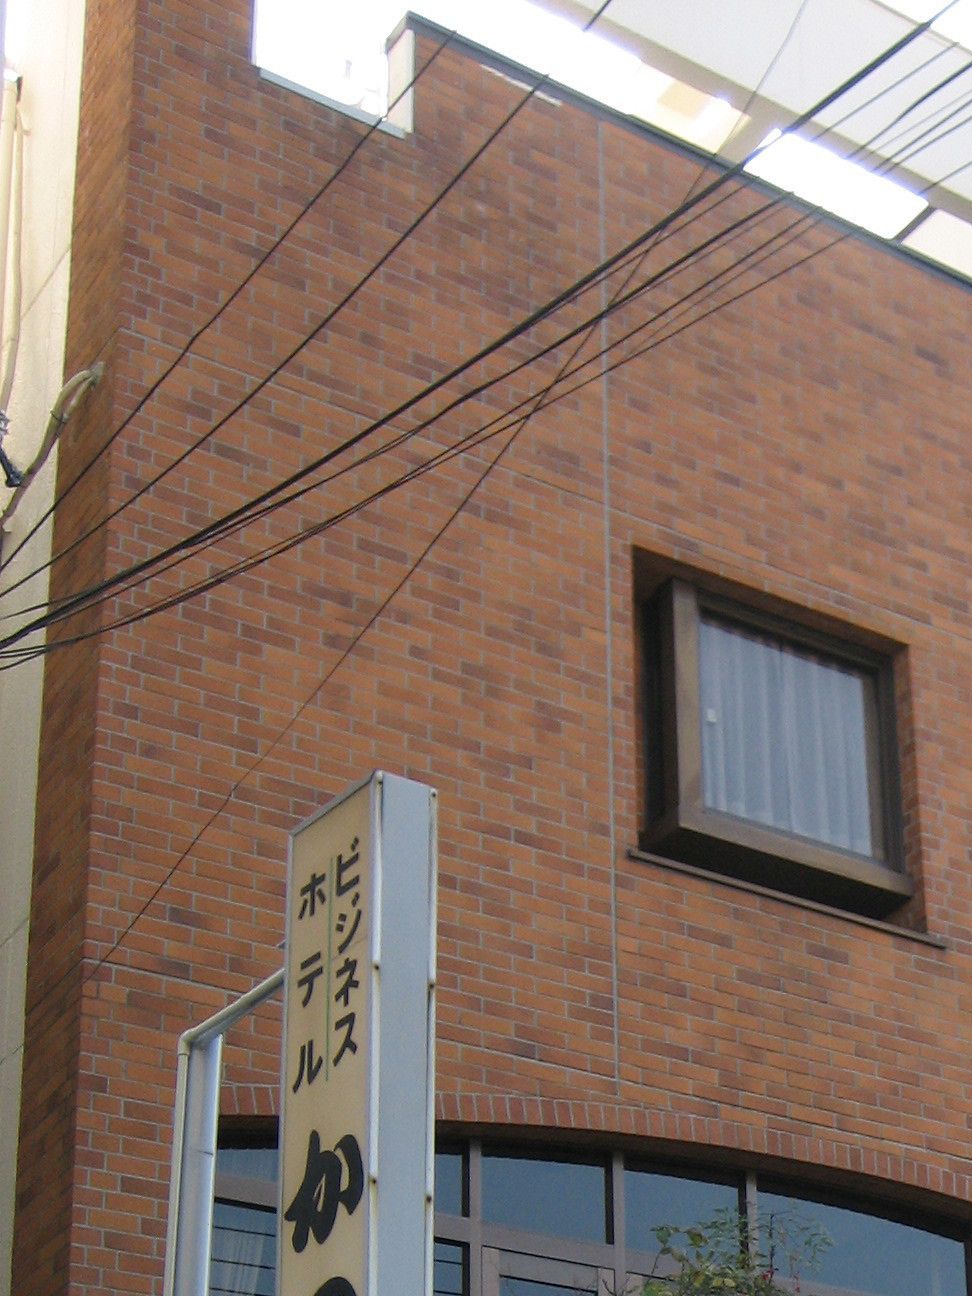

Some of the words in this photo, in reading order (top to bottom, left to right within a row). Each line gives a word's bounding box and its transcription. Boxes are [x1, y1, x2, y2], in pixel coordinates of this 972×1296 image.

[293, 873, 326, 1093] ホテル
[332, 837, 362, 1067] ビジネス
